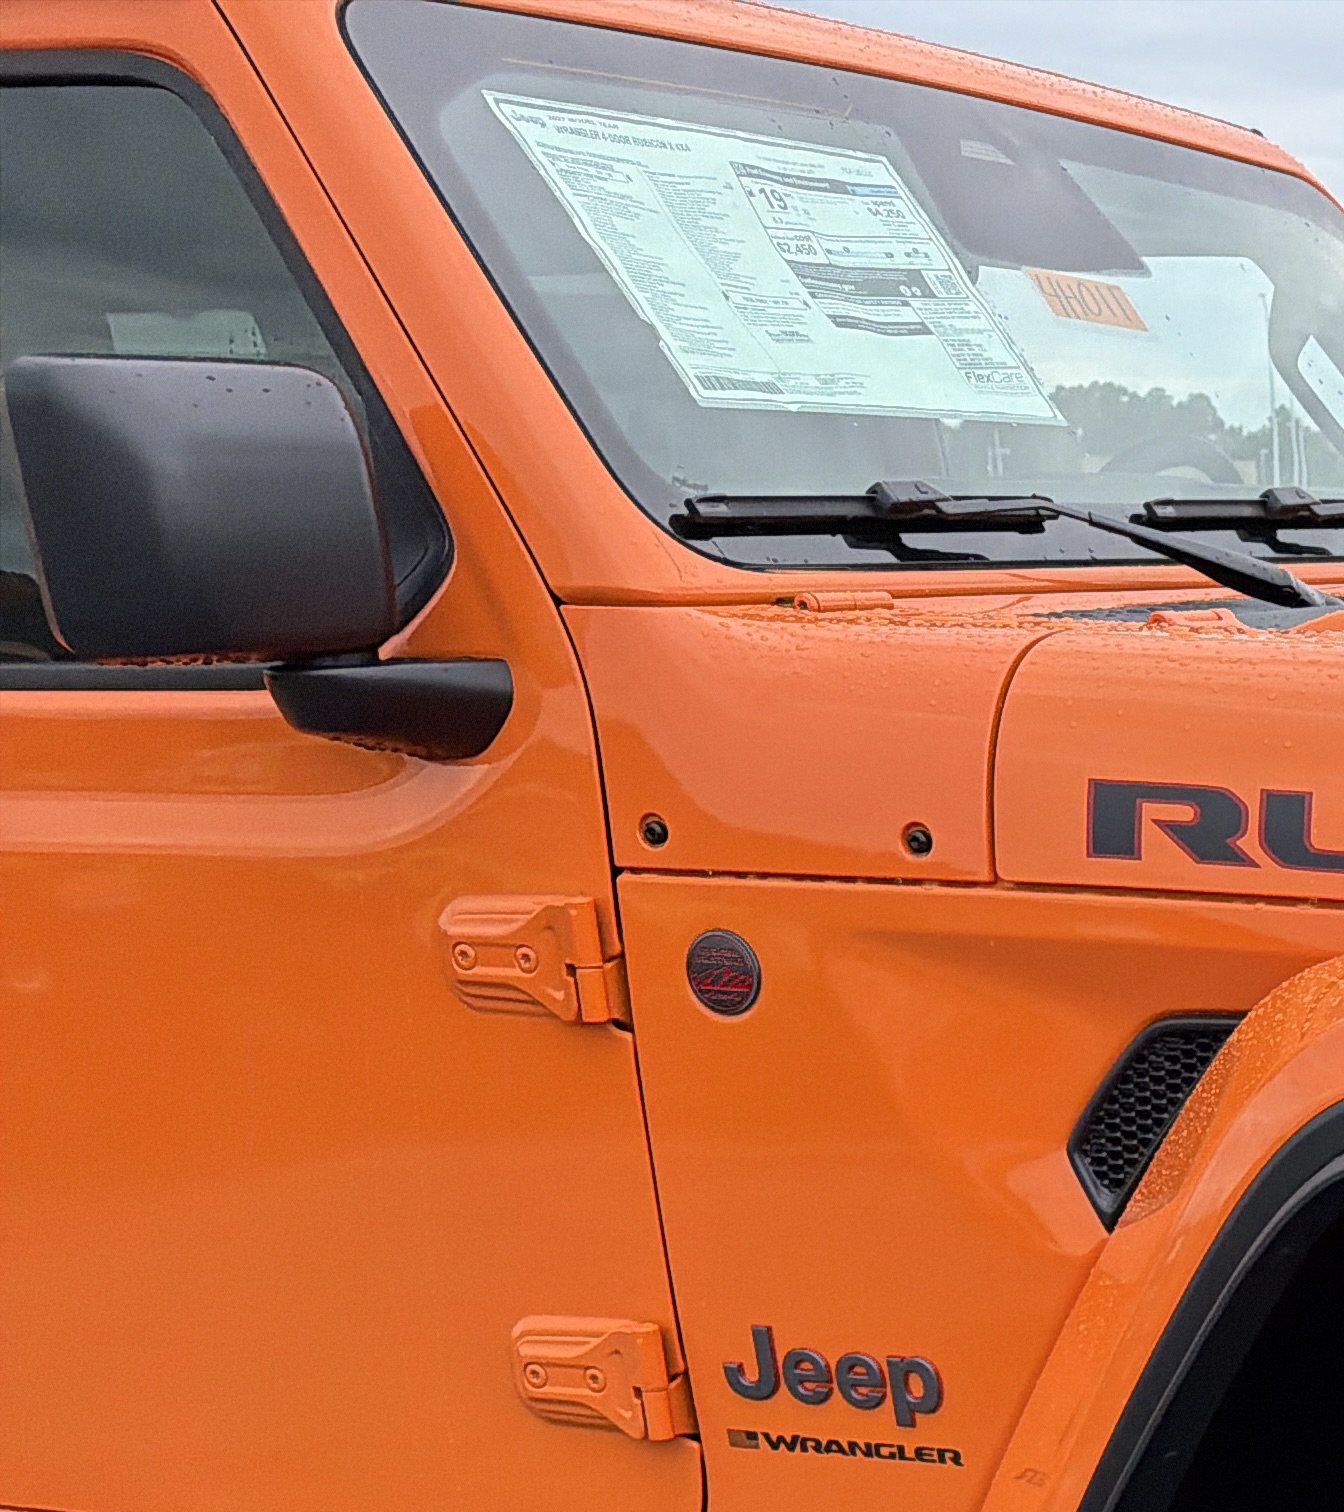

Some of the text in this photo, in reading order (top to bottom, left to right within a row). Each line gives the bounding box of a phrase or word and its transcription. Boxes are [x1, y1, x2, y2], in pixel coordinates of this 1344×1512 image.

[758, 187, 788, 211] 19
[776, 241, 818, 257] $2,450
[964, 370, 1025, 384] FlexCare
[723, 1323, 944, 1428] Jeep
[760, 1431, 964, 1467] WRANGLER
